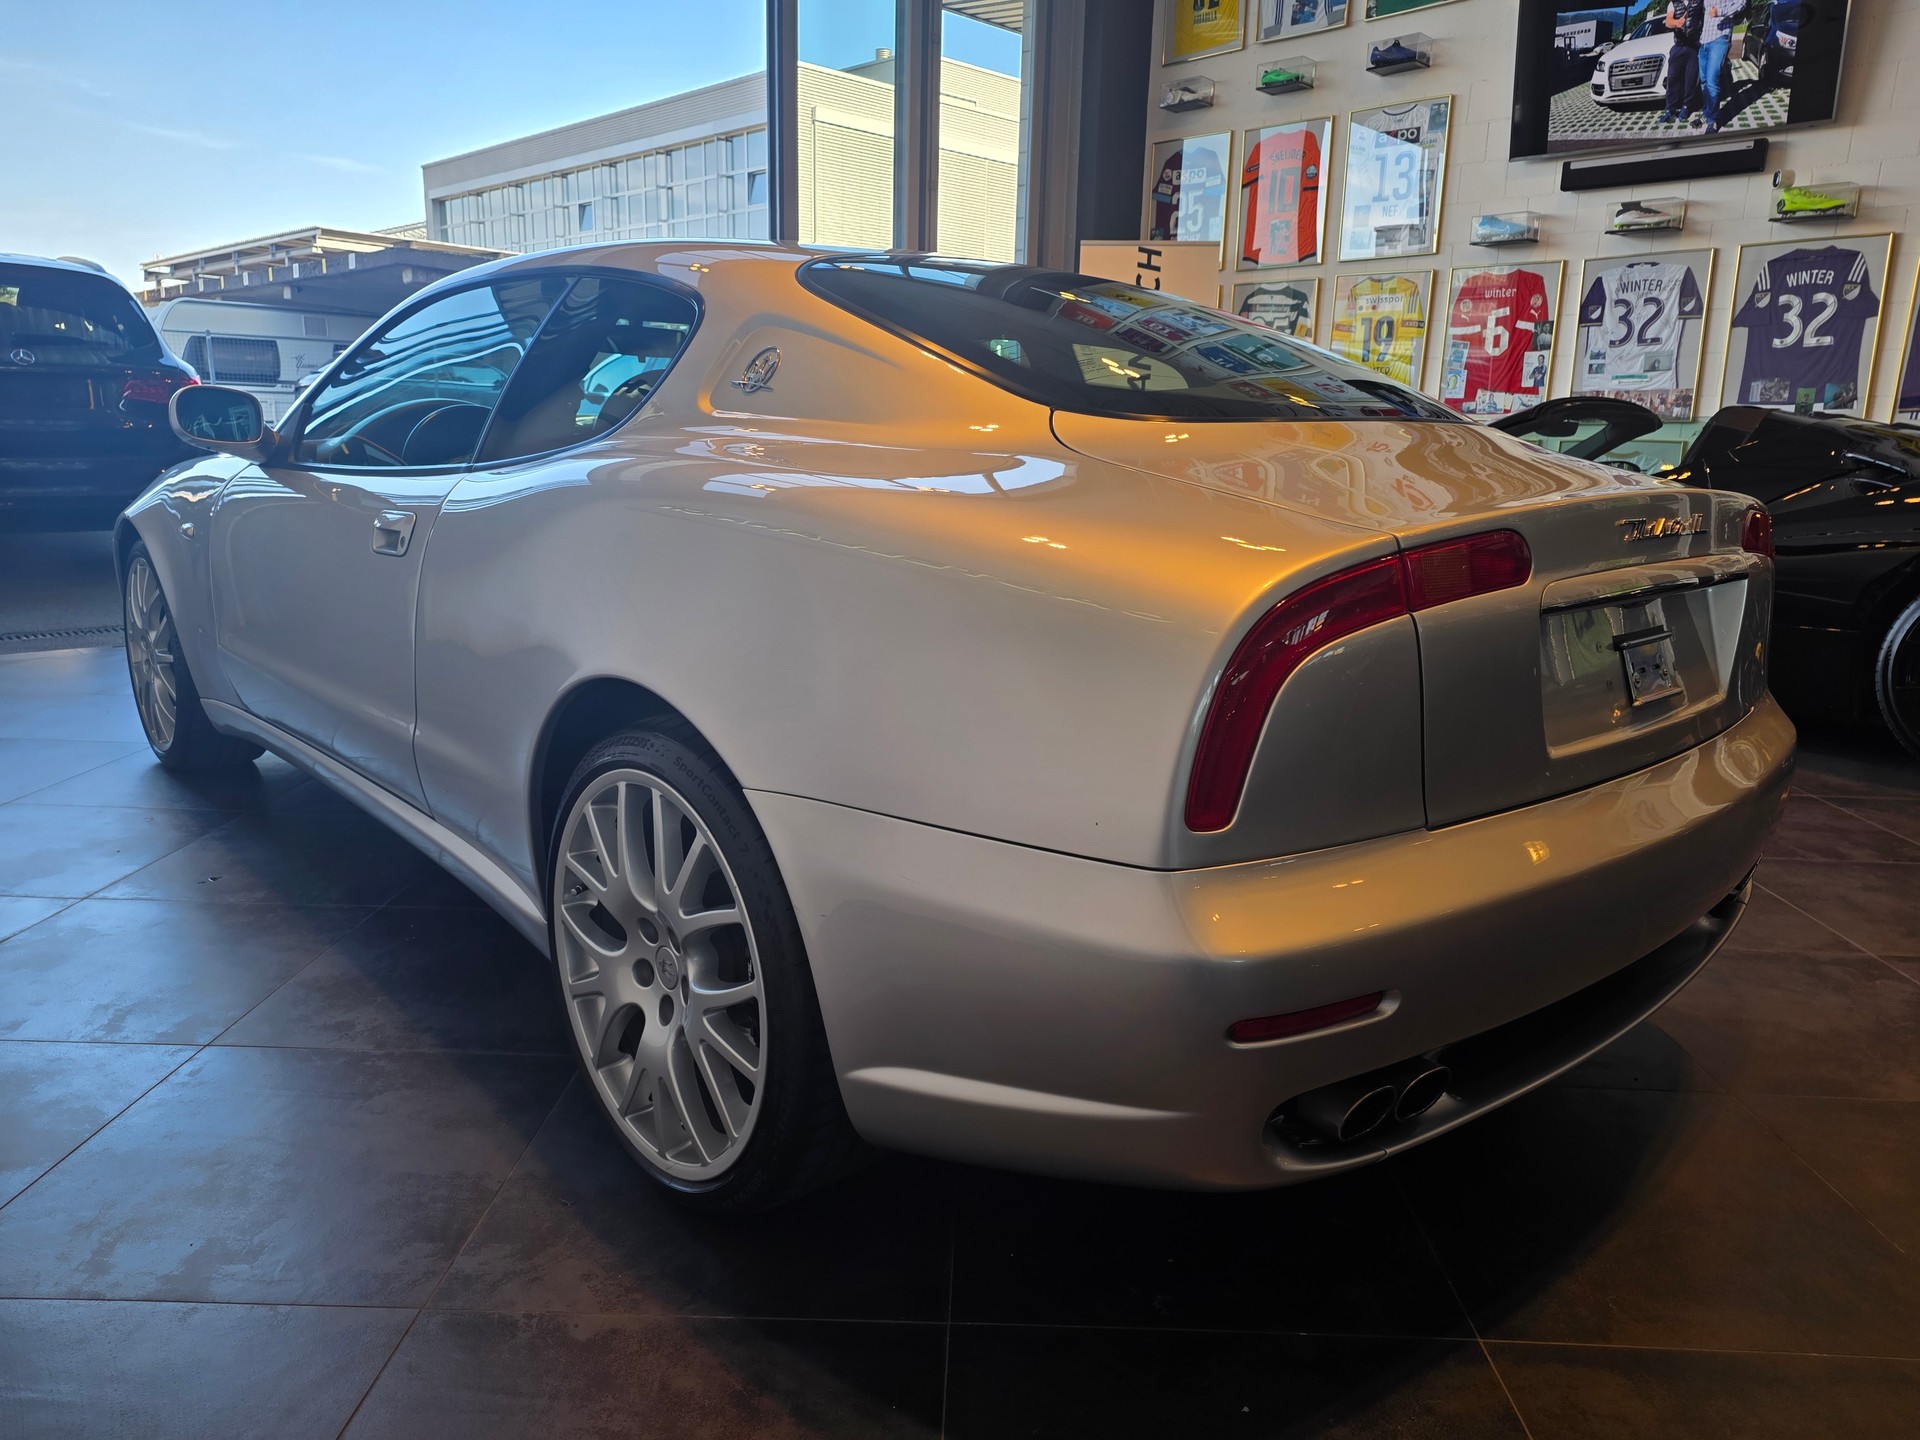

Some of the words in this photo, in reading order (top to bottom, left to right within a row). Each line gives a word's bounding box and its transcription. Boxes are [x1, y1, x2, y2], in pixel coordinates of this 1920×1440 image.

[1270, 150, 1307, 165] SNEIJDER
[1371, 150, 1417, 202] 13
[1169, 189, 1204, 234] 25
[1268, 166, 1301, 214] 10
[1382, 204, 1399, 218] NEF
[1484, 287, 1517, 299] winter
[1620, 279, 1663, 294] WINTER
[1786, 269, 1835, 288] WINTER
[1361, 316, 1395, 362] 19
[1483, 306, 1510, 356] 6
[1609, 296, 1665, 348] 32
[1772, 292, 1838, 348] 32
[672, 756, 741, 840] SportContact
